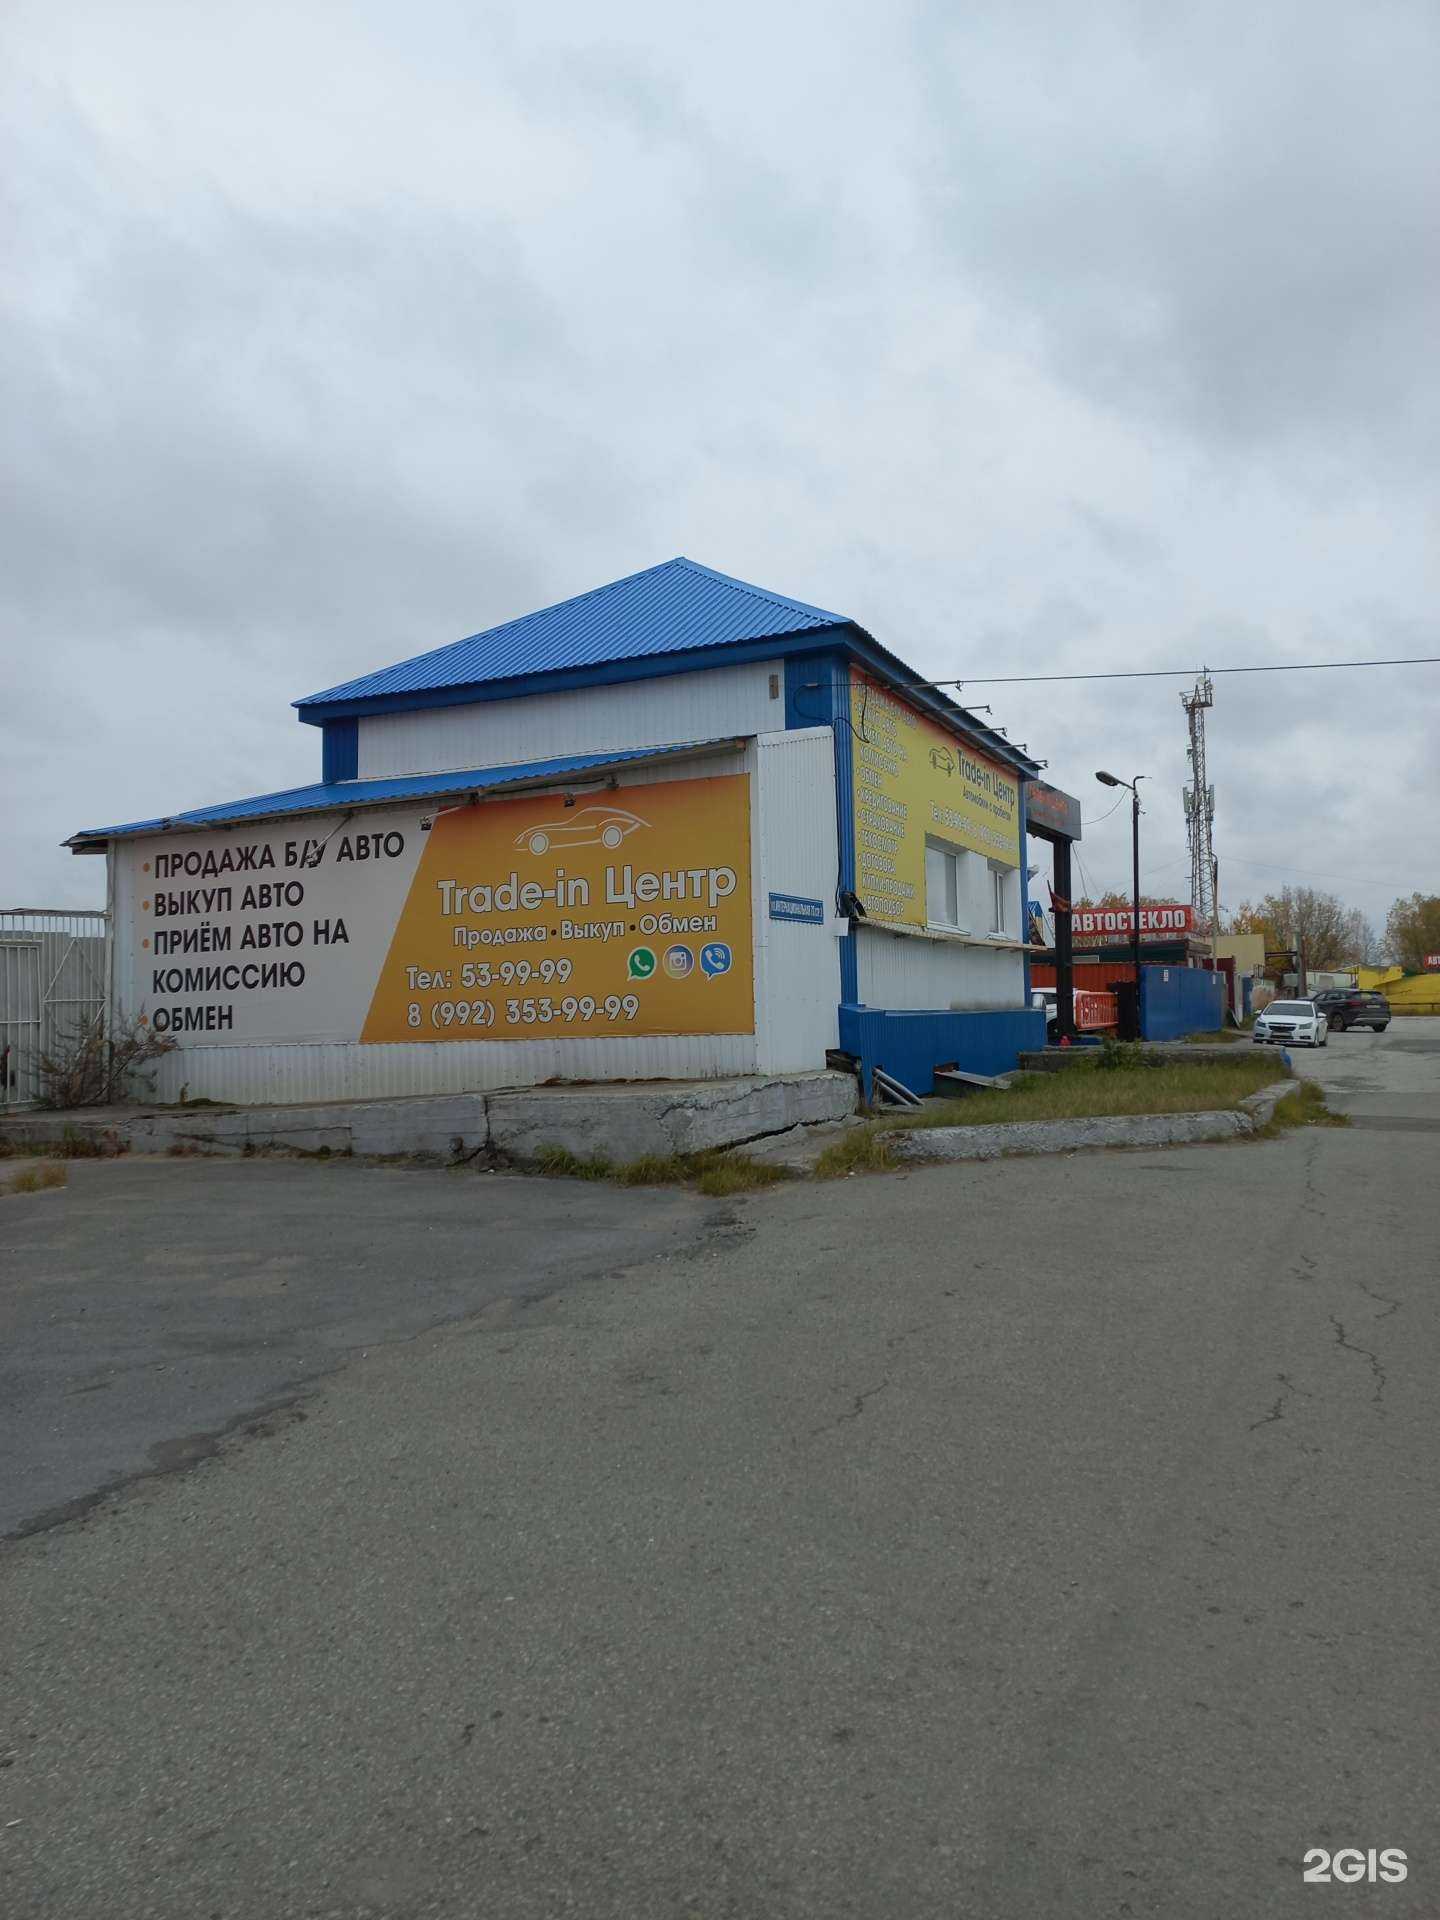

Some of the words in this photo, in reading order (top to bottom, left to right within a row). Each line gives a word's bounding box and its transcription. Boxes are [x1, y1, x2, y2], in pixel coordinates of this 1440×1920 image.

[956, 748, 991, 792] Trade-in
[992, 770, 1015, 811] Центр
[154, 844, 275, 879] ПРОДАЖА
[336, 832, 405, 862] АВТО
[154, 887, 232, 917] ВЫКУП
[240, 881, 304, 911] АВТО
[437, 868, 590, 916] Trade-in
[605, 864, 737, 909] Центр
[153, 922, 231, 955] ПРИЁМ
[240, 921, 303, 950] АВТО
[314, 918, 349, 945] НА
[453, 925, 547, 949] Продажа
[560, 918, 625, 946] Выкуп
[639, 913, 717, 937] Обмен
[1071, 909, 1186, 932] АВТОСТЕКЛО
[153, 961, 305, 994] КОМИССИЮ
[405, 965, 453, 991] Тел:
[461, 958, 573, 988] 53-99-99
[153, 1005, 233, 1032] ОБМЕН
[406, 1002, 422, 1028] 8
[431, 1000, 496, 1029] (992)
[505, 994, 640, 1025] 353-99-99
